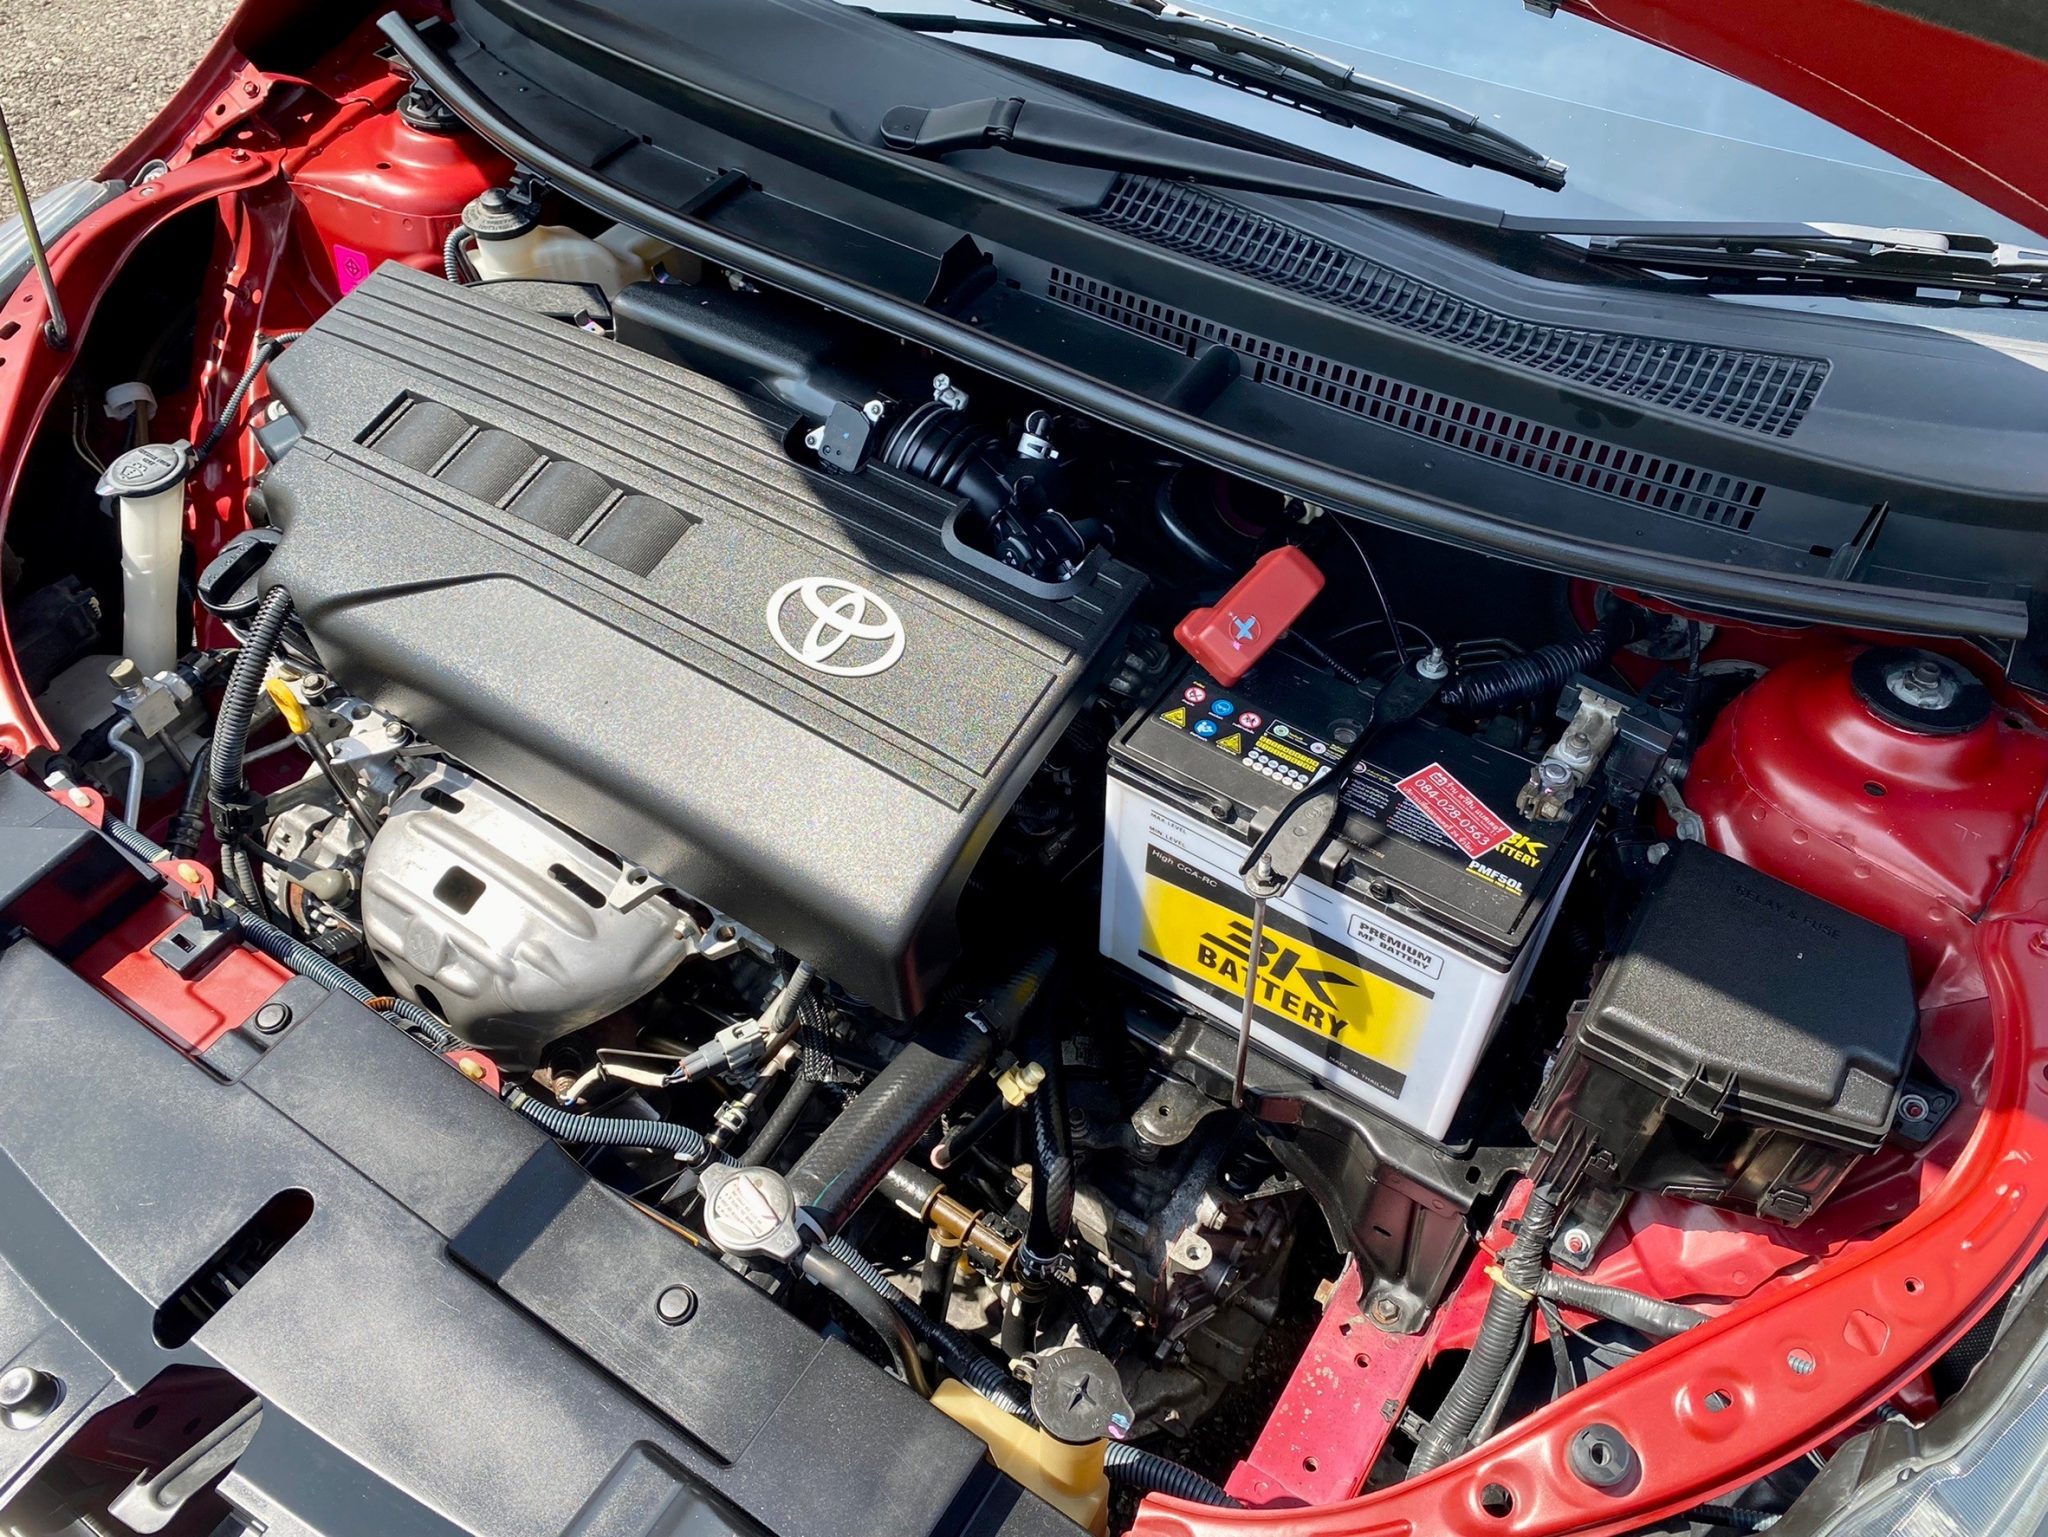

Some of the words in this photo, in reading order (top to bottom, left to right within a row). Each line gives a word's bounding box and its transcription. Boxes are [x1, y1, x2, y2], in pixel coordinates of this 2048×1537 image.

[1168, 821, 1187, 835] LEVEL
[1415, 779, 1490, 846] 084-028-0563
[1165, 833, 1186, 848] LEVEL
[1494, 843, 1541, 868] TTERY
[1152, 849, 1175, 866] High
[1176, 863, 1218, 888] CCA-RC
[1736, 885, 1784, 912] RELAY
[1803, 916, 1841, 940] FUSE
[1357, 931, 1375, 944] MF
[1379, 940, 1430, 971] BATTERY
[1358, 921, 1432, 964] PREMIUM
[1200, 920, 1361, 1012] BK
[1329, 1055, 1349, 1070] MADE
[1350, 1067, 1360, 1077] IN
